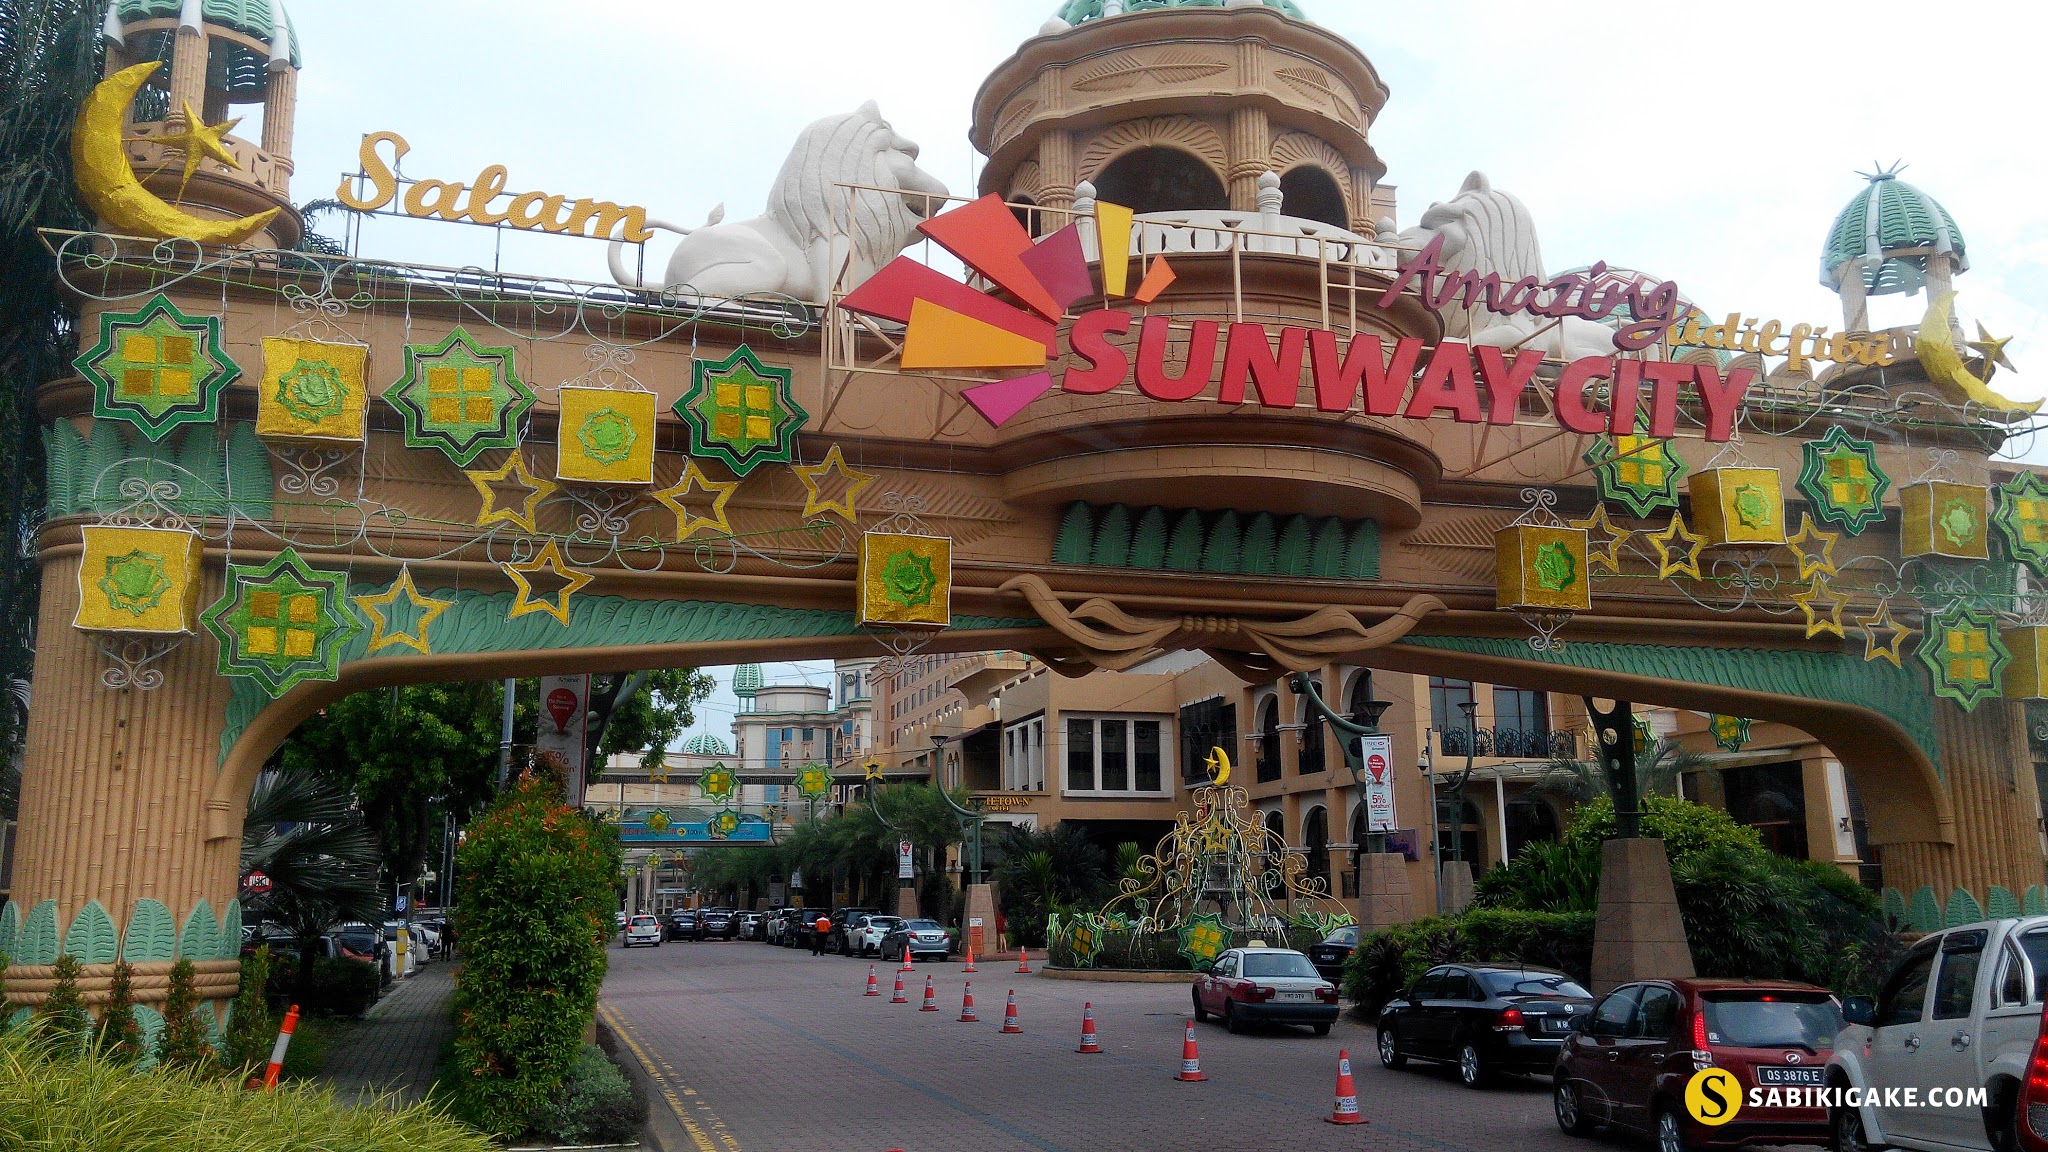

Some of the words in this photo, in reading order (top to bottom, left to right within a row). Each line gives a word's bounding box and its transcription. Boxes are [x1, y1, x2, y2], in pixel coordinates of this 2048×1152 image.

[336, 131, 654, 243] Salam
[1378, 231, 1694, 350] Amazing
[1061, 309, 1545, 425] SUNWAY
[1554, 355, 1755, 443] CITY
[1767, 1069, 1781, 1080] QS
[1783, 1070, 1810, 1081] 3876
[1812, 1071, 1820, 1081] E
